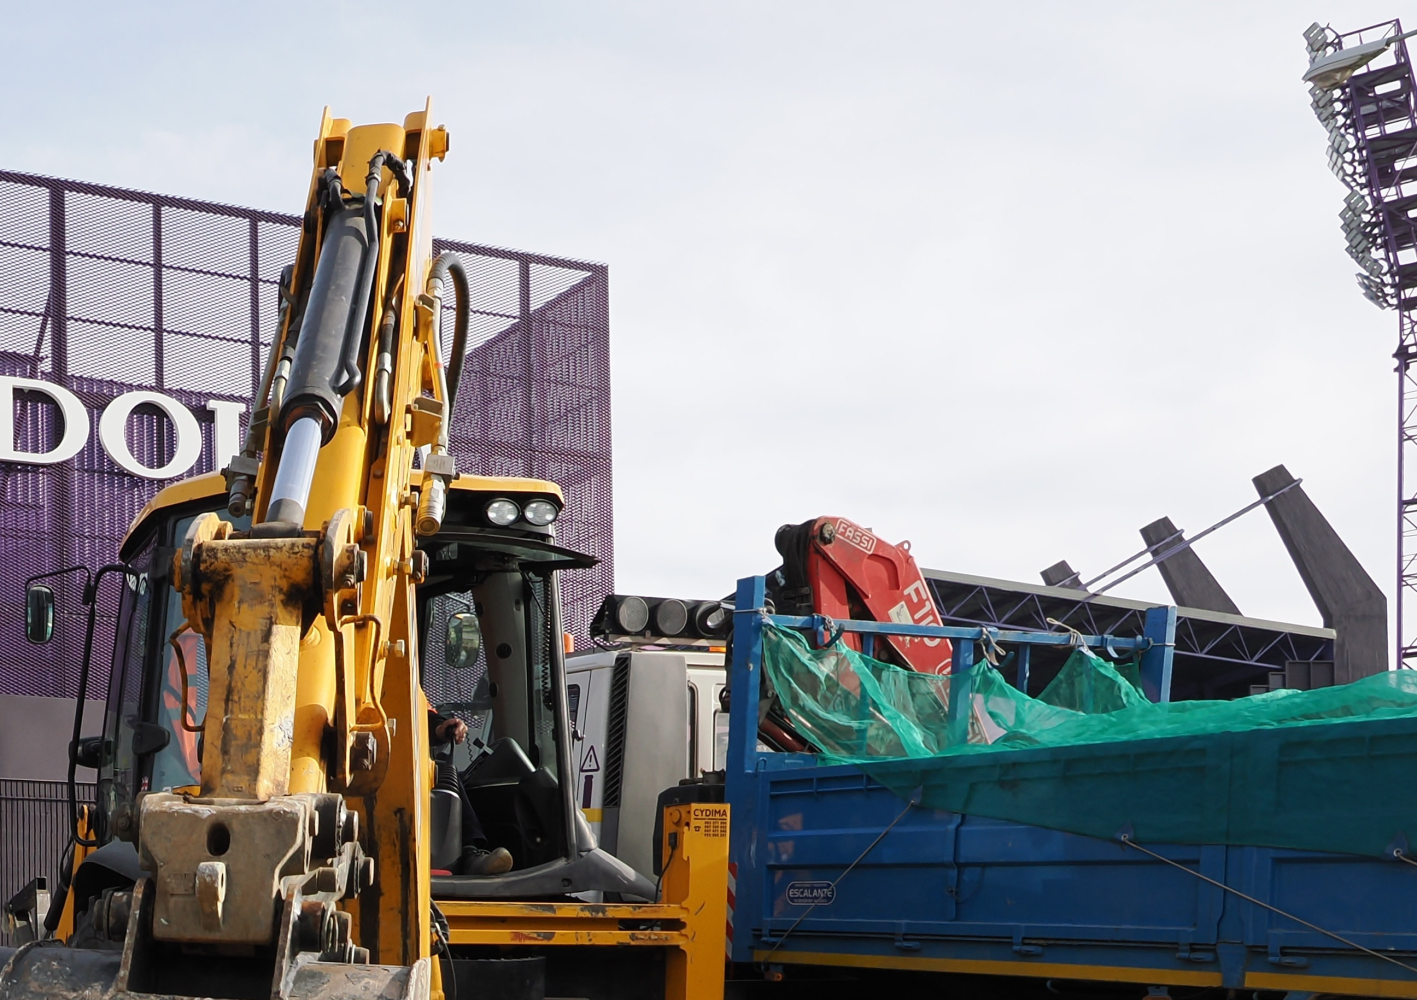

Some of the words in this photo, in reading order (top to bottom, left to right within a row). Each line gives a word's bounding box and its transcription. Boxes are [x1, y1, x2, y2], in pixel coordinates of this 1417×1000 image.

[837, 521, 874, 550] FASSI
[693, 808, 728, 817] CYDIMA
[789, 888, 833, 898] ESCALANTE
